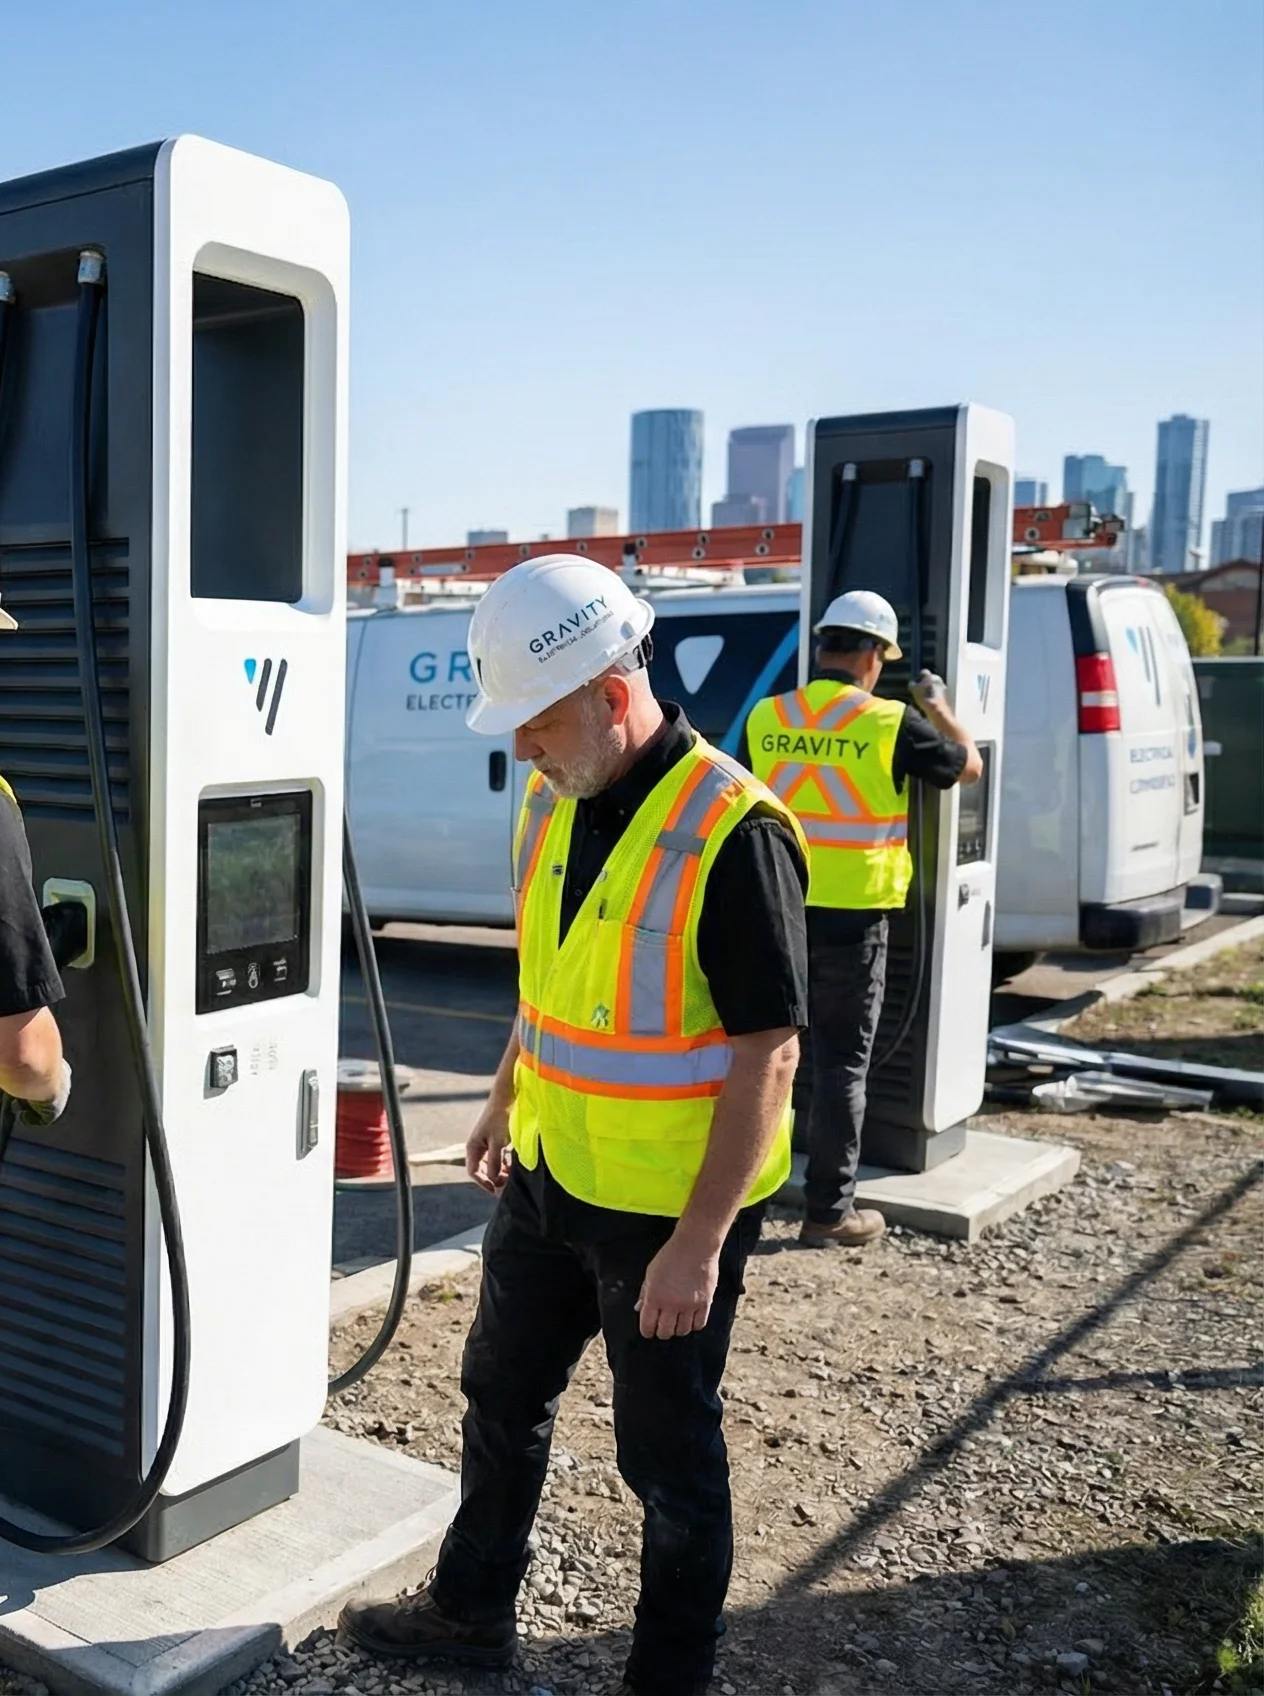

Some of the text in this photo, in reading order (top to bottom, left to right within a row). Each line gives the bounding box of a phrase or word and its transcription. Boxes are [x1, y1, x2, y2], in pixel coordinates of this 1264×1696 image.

[529, 595, 607, 653] GRAVITY
[410, 652, 471, 683] GR
[762, 734, 869, 759] GRAVITY
